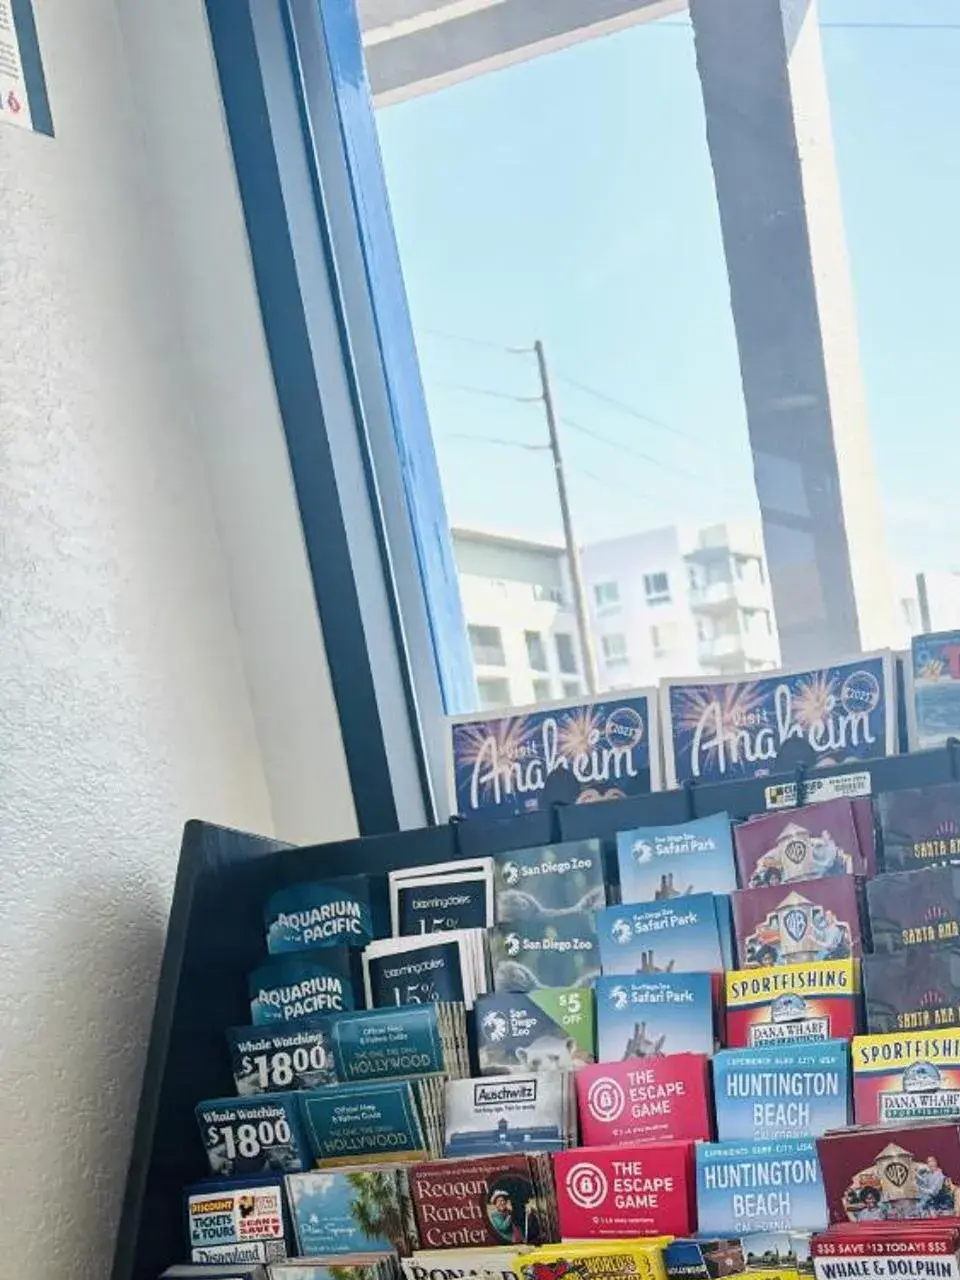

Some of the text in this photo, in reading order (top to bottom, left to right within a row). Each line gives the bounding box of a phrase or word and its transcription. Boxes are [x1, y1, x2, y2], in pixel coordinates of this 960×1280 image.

[692, 684, 876, 777] Anaheim
[656, 840, 716, 856] Safari Park
[914, 840, 946, 858] SANTA
[521, 859, 592, 877] San Diego Zoo
[276, 900, 361, 931] AQUARIUM
[304, 918, 362, 944] PACIFIC
[731, 971, 848, 999] SPORTFISHING
[562, 1015, 582, 1025] OFF
[350, 1055, 431, 1075] HOLLYWOOD
[627, 1070, 655, 1084] THE
[727, 1072, 839, 1097] HUNTINGTON
[477, 1087, 534, 1102] Auschwitz
[629, 1081, 685, 1102] ESCAPE
[885, 1093, 960, 1109] DANA WHARF
[203, 1107, 285, 1123] Whale Watching
[631, 1101, 671, 1118] GAME
[753, 1102, 811, 1126] BEACH
[704, 1158, 817, 1189] HUNTINGTON
[416, 1178, 490, 1202] Reagan
[420, 1203, 483, 1222] Ranch
[733, 1191, 791, 1218] BEACH
[193, 1215, 233, 1229] TICKETS
[201, 1226, 236, 1241] TOURS
[426, 1226, 488, 1248] Center
[821, 1259, 951, 1279] WHALE & DOLPHIN
